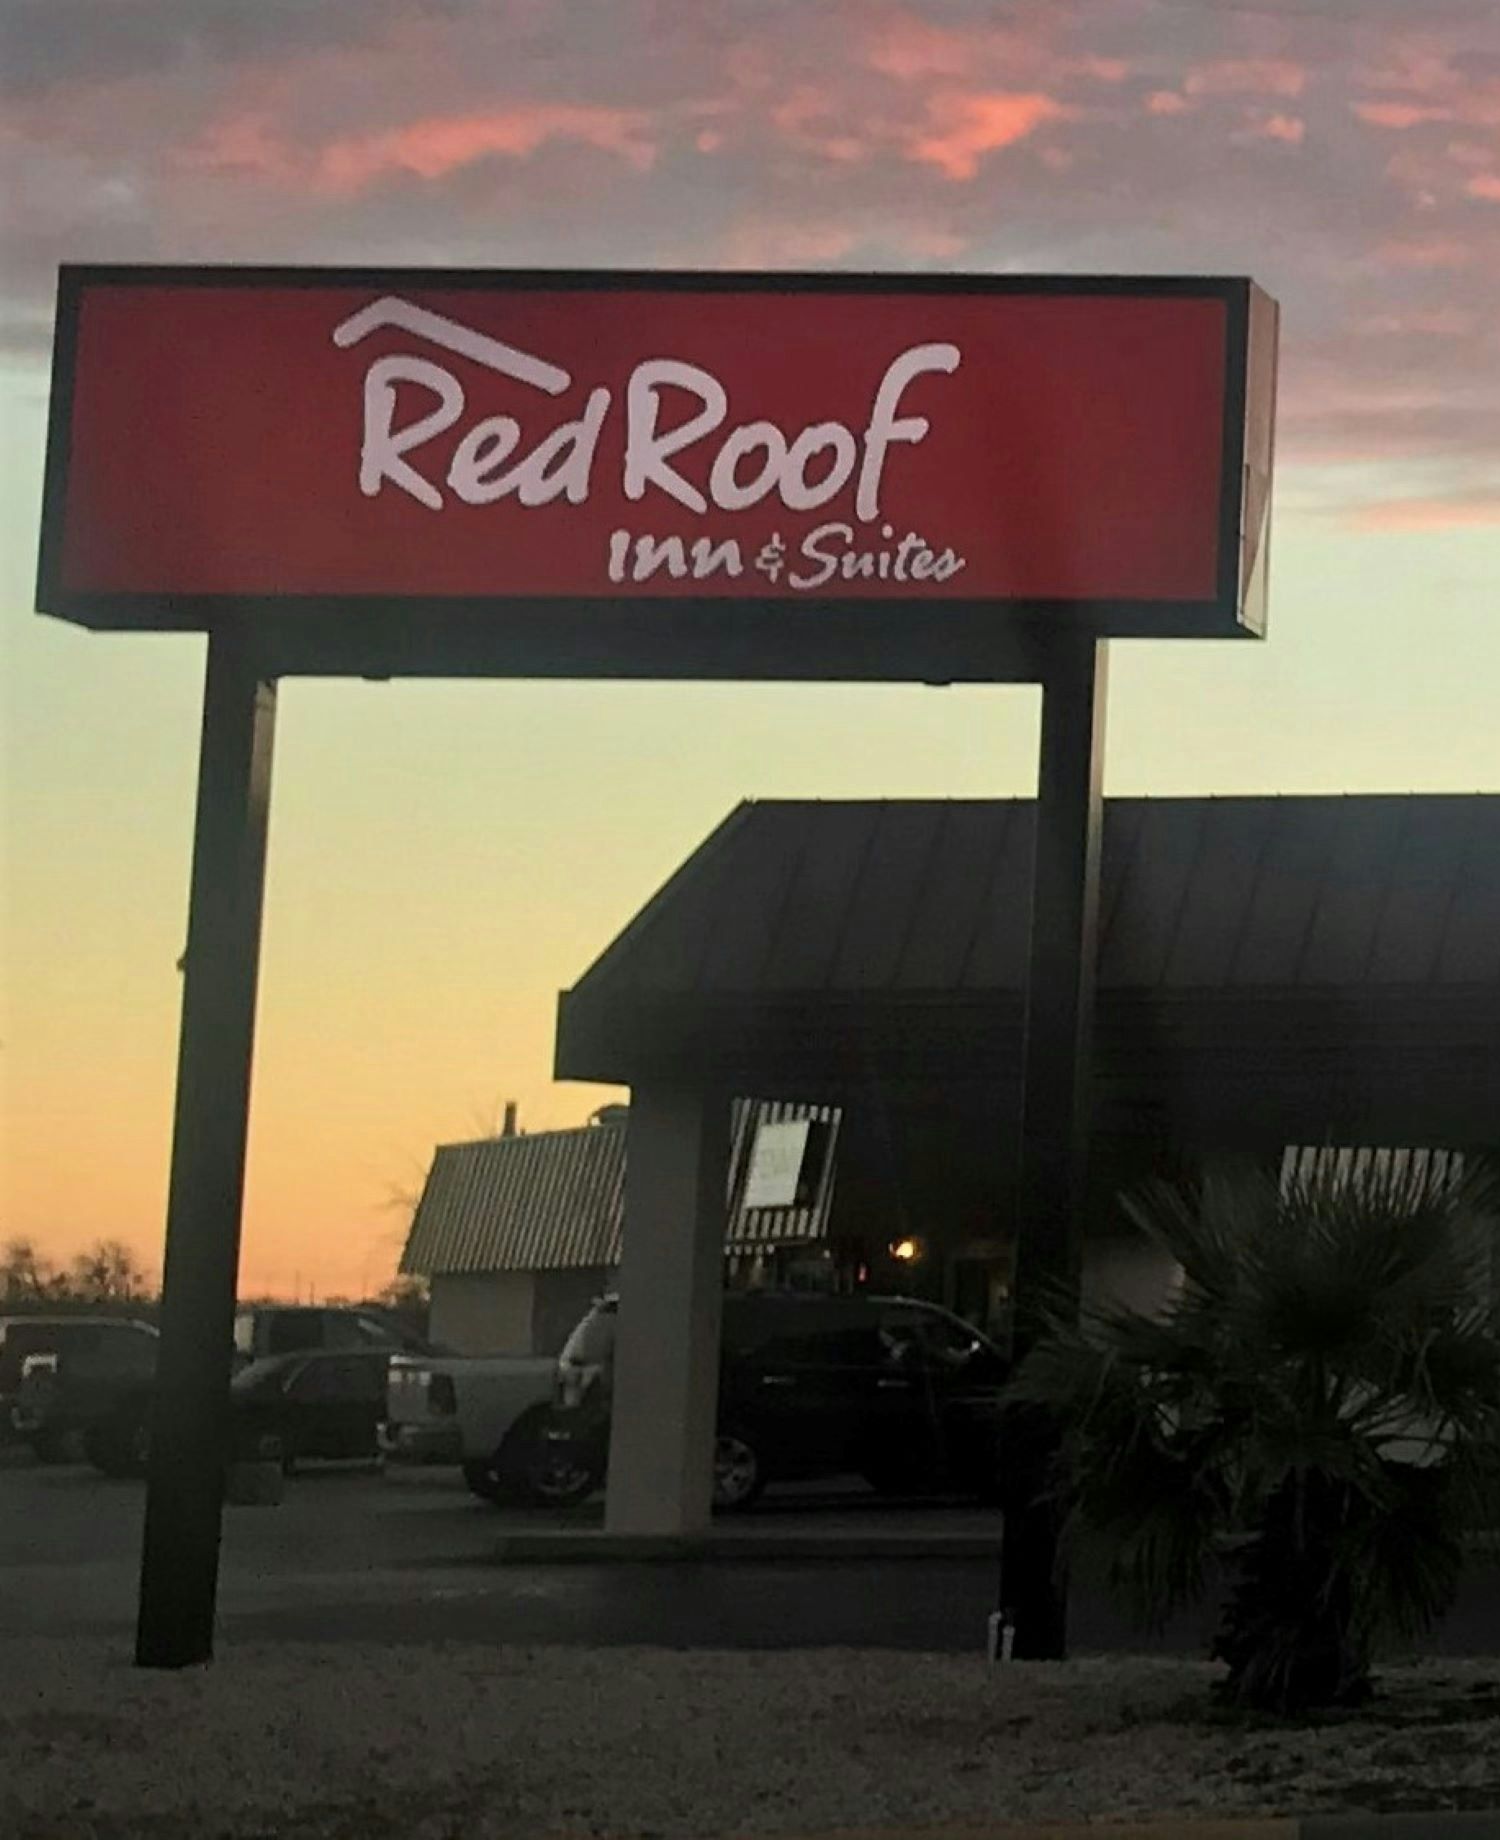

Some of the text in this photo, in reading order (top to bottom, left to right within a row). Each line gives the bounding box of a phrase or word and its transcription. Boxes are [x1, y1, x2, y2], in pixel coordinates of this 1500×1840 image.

[357, 343, 962, 523] Red Roof
[755, 531, 786, 584] &
[788, 521, 967, 589] Suites
